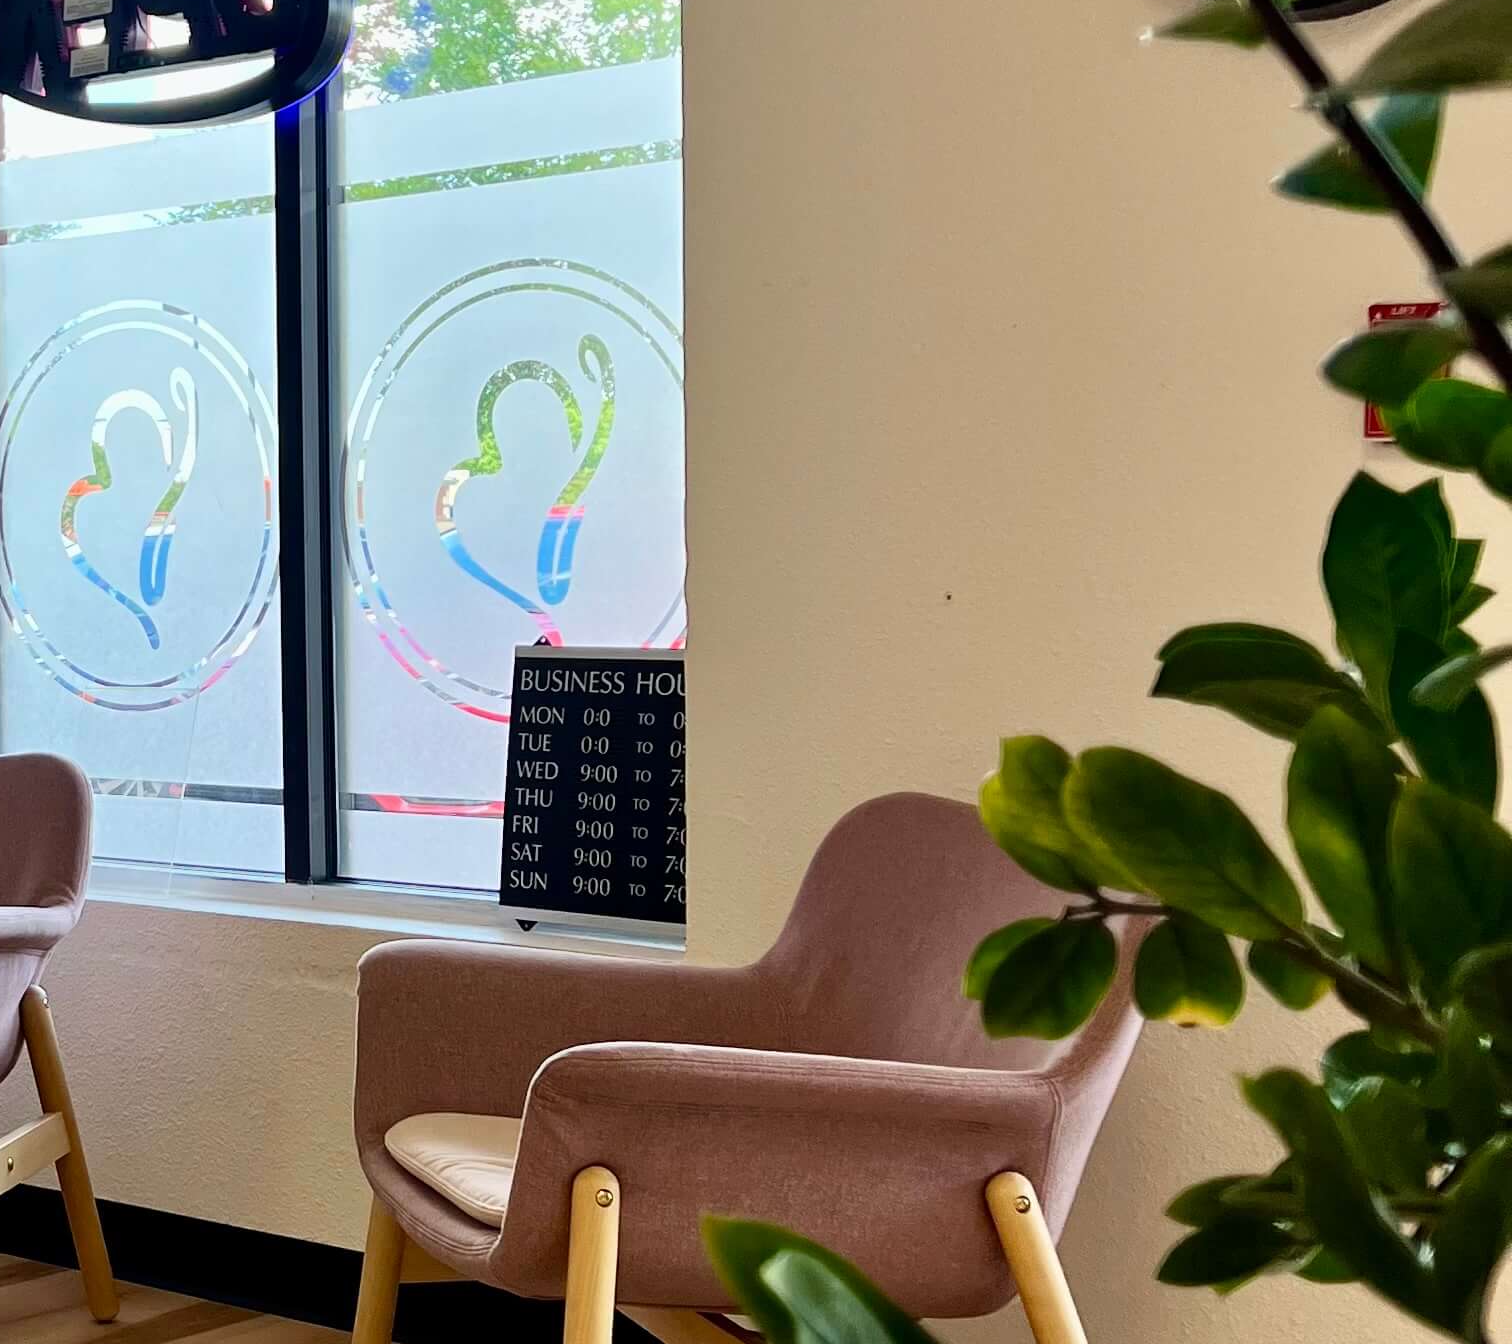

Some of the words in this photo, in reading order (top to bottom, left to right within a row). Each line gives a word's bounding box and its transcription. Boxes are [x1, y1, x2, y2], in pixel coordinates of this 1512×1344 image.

[520, 669, 625, 695] BUSINESS
[519, 706, 565, 725] MON
[583, 708, 611, 727] 0:0
[638, 712, 655, 726] TO
[518, 732, 552, 752] TUE
[580, 735, 609, 755] 0:0
[637, 741, 654, 754] TO
[516, 760, 559, 780] WED
[580, 764, 618, 783] 9:00
[635, 769, 652, 783] TO
[514, 787, 553, 808] THU
[577, 791, 616, 812] 9:00
[633, 798, 650, 811] TO
[512, 814, 539, 834] FRI
[575, 820, 614, 840] 9:00
[632, 826, 649, 840] TO
[510, 842, 543, 862] SAT
[574, 847, 612, 868] 9:00
[631, 855, 648, 868] TO
[509, 869, 548, 890] SUN
[572, 875, 611, 897] 9:00
[629, 883, 646, 897] TO
